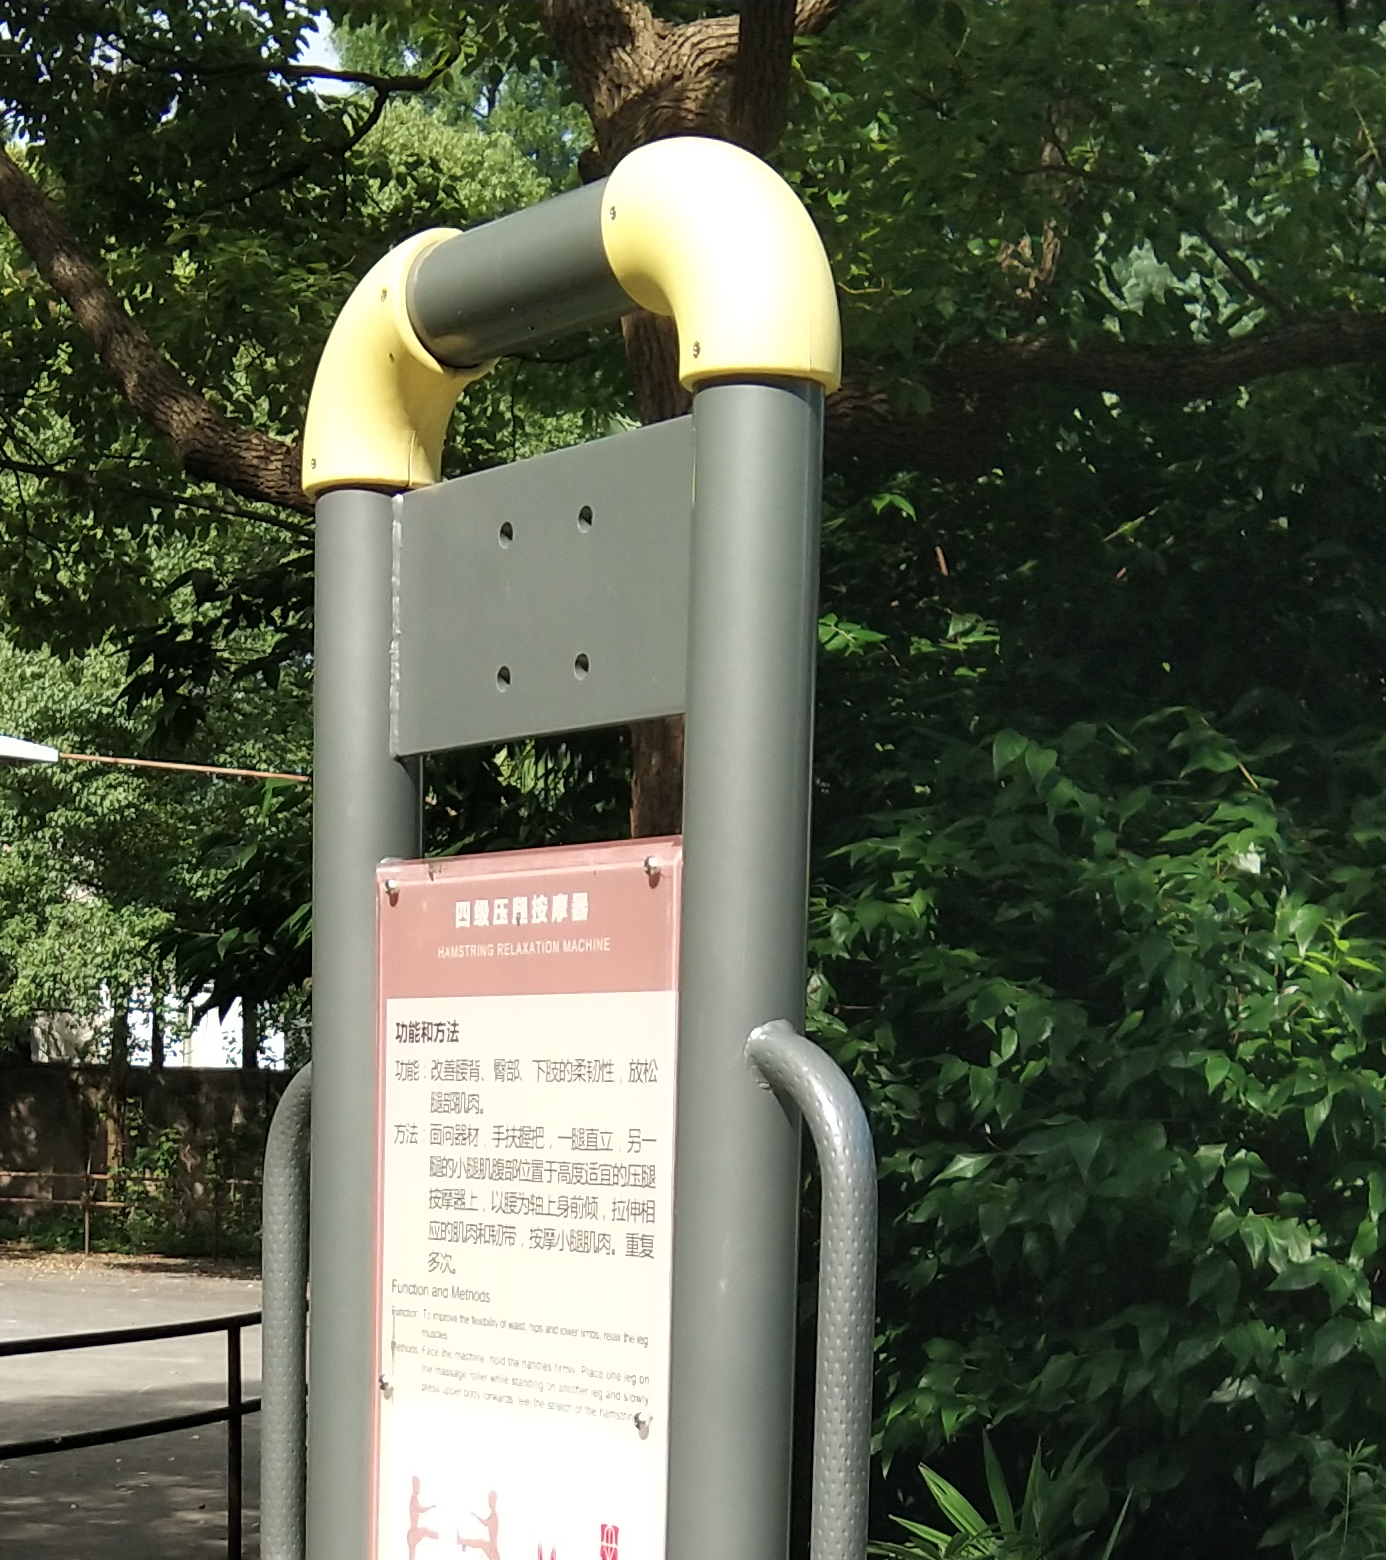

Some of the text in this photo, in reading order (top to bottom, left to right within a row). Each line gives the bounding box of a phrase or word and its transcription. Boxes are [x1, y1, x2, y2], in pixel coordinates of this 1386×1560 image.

[455, 892, 589, 929] 四级压腿按摩器
[437, 937, 611, 959] HAMSTRING RELAXATION MACHINE
[394, 1019, 460, 1044] 功能和方法
[426, 1251, 457, 1275] 多次。
[391, 1279, 491, 1304] Function and Methods
[581, 1365, 604, 1380] Place
[639, 1375, 650, 1386] on
[605, 1388, 622, 1402] and
